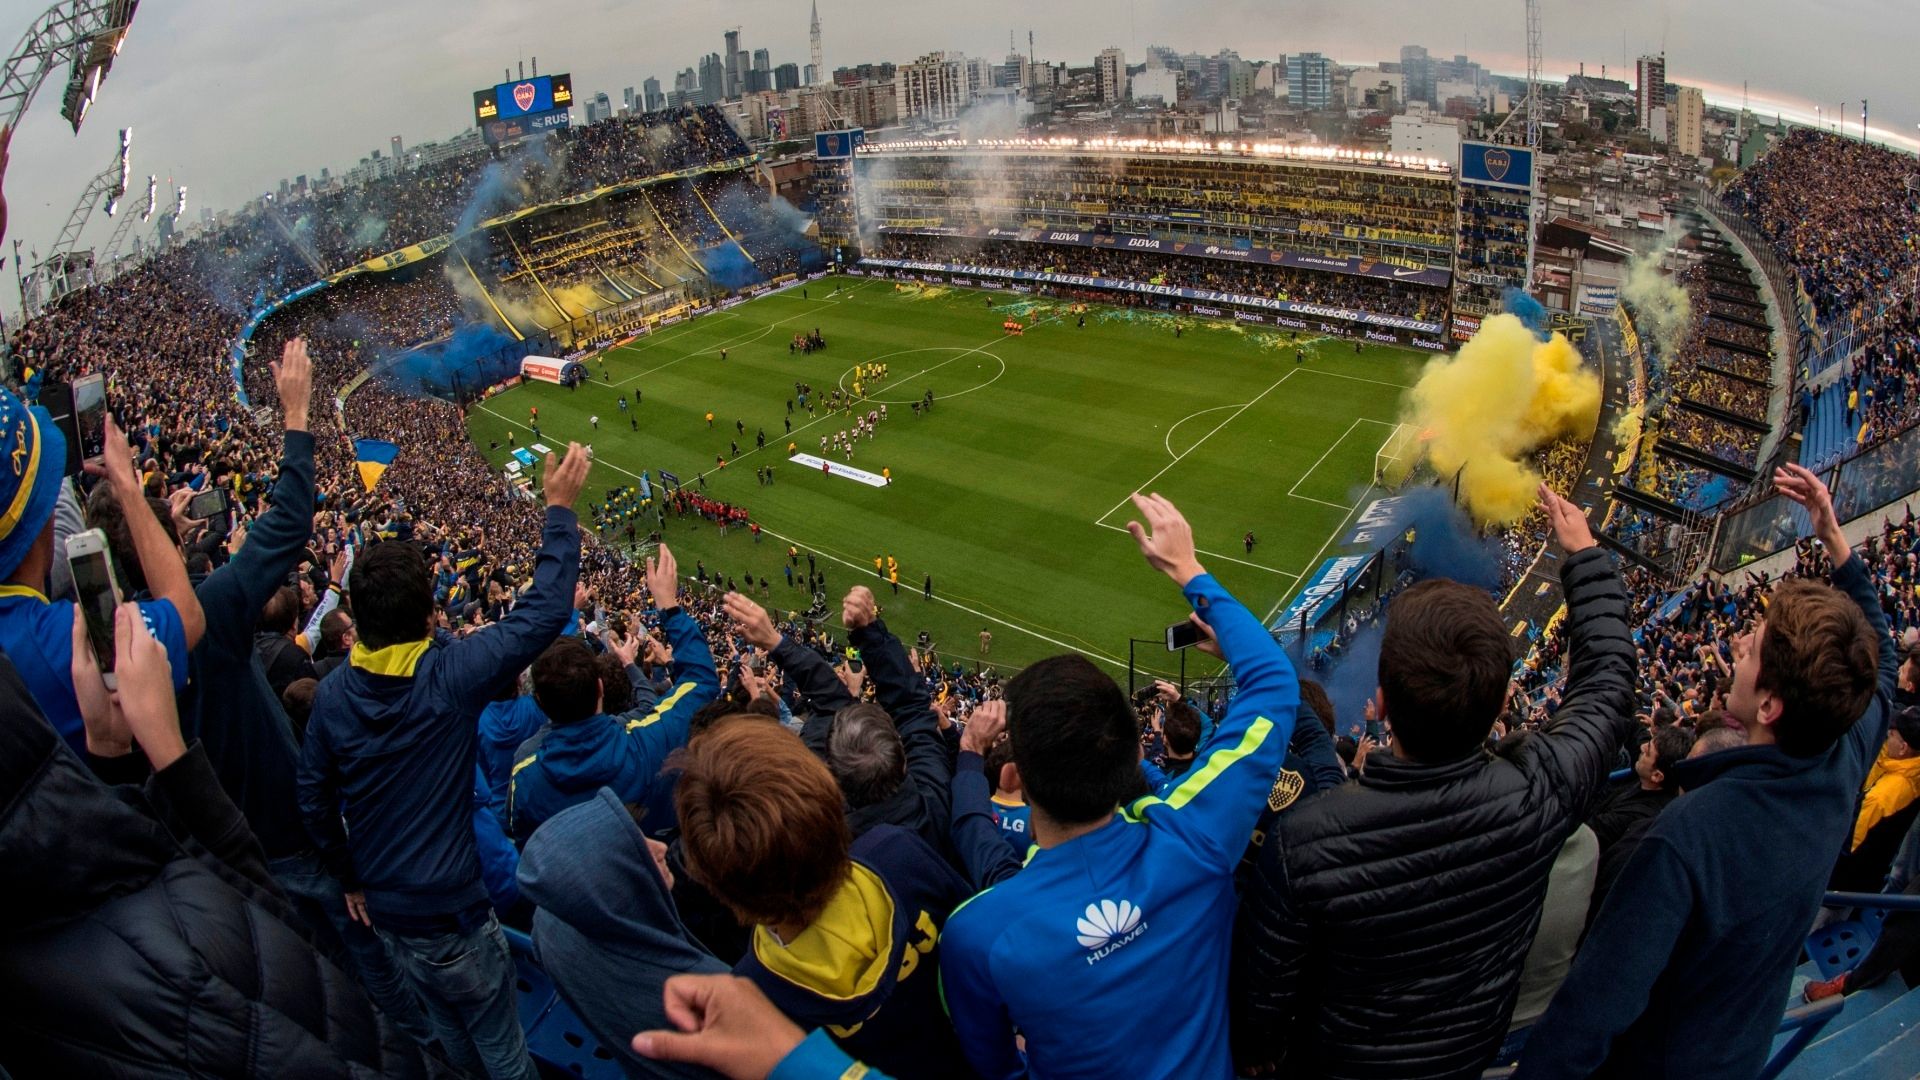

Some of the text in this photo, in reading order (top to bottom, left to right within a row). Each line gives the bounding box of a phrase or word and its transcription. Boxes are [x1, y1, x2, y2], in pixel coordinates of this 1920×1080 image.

[545, 113, 568, 126] RUS
[1050, 232, 1080, 242] BBVA
[1128, 238, 1160, 249] BBVA
[1220, 249, 1249, 257] HUAWEI
[1305, 257, 1322, 265] MITAD
[962, 265, 1015, 278] LA NUEVA
[780, 278, 799, 288] Polacrin
[951, 277, 972, 286] Polacrin
[980, 280, 1002, 289] Polacrin
[1035, 272, 1094, 286] LA NUEVA
[751, 286, 772, 297] Polacrin
[1117, 282, 1183, 296] LA NUEVA
[721, 294, 743, 305] Polacrin
[1209, 291, 1281, 309] LA NUEVA
[691, 303, 713, 315] Polacrin
[1193, 305, 1221, 316] Polacrin
[660, 314, 682, 326] Polacrin
[1234, 311, 1263, 323] Polacrin
[1277, 316, 1307, 329] Polacrin
[1453, 318, 1479, 329] TORNEO
[1366, 330, 1397, 343] Polacrin
[1412, 337, 1444, 351] Polacrin
[564, 349, 586, 362] Polacrin
[1274, 781, 1297, 794] ABJ
[1001, 816, 1025, 833] LG
[1085, 920, 1149, 966] HUAWEI
